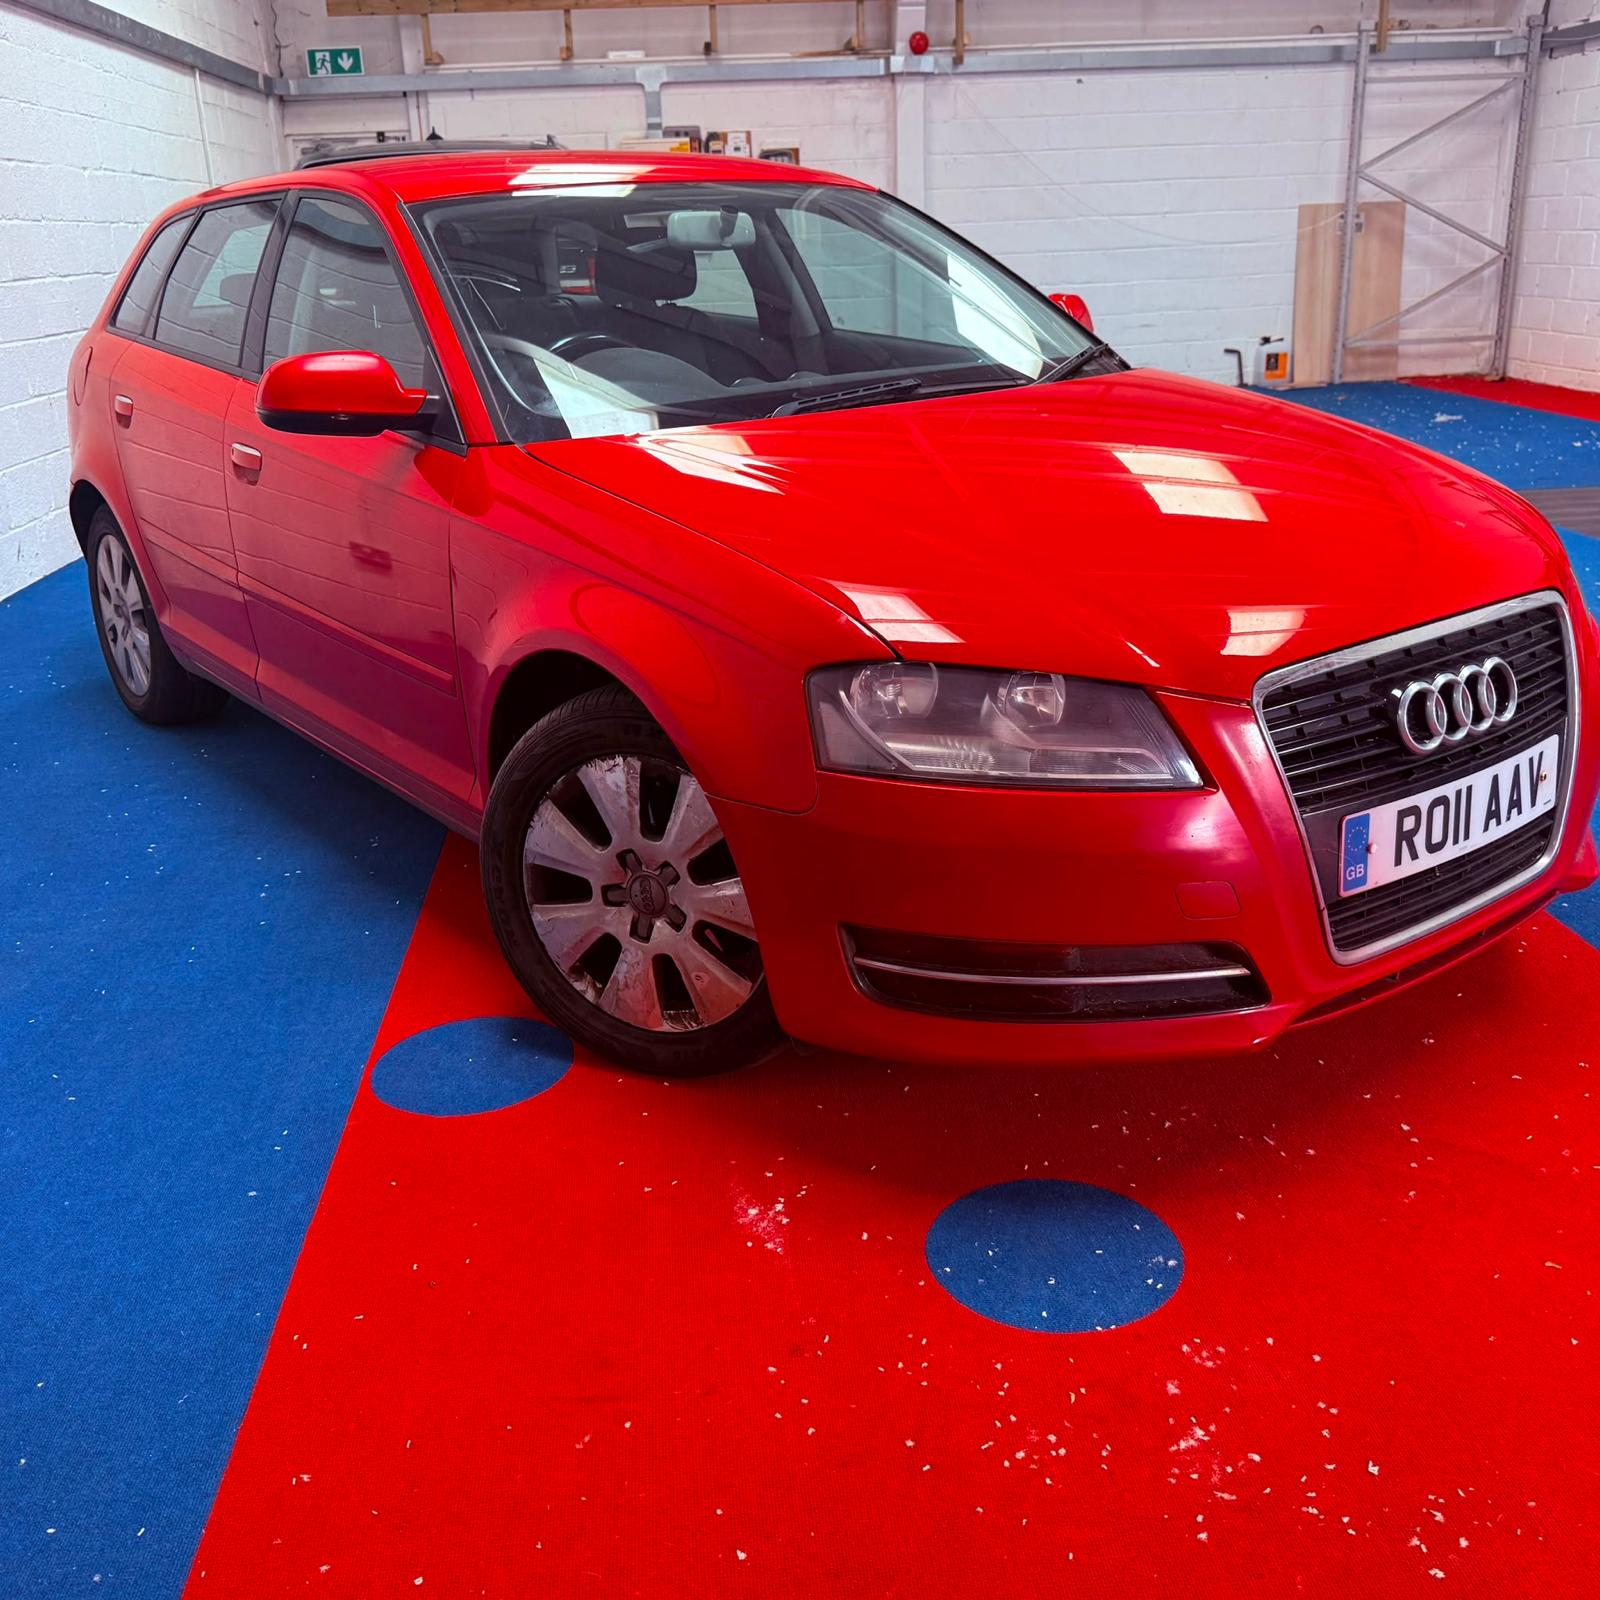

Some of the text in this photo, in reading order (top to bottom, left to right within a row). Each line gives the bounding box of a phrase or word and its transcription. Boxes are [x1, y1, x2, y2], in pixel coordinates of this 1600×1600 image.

[1394, 751, 1544, 867] RO11 AAV
[1346, 864, 1364, 880] GB
